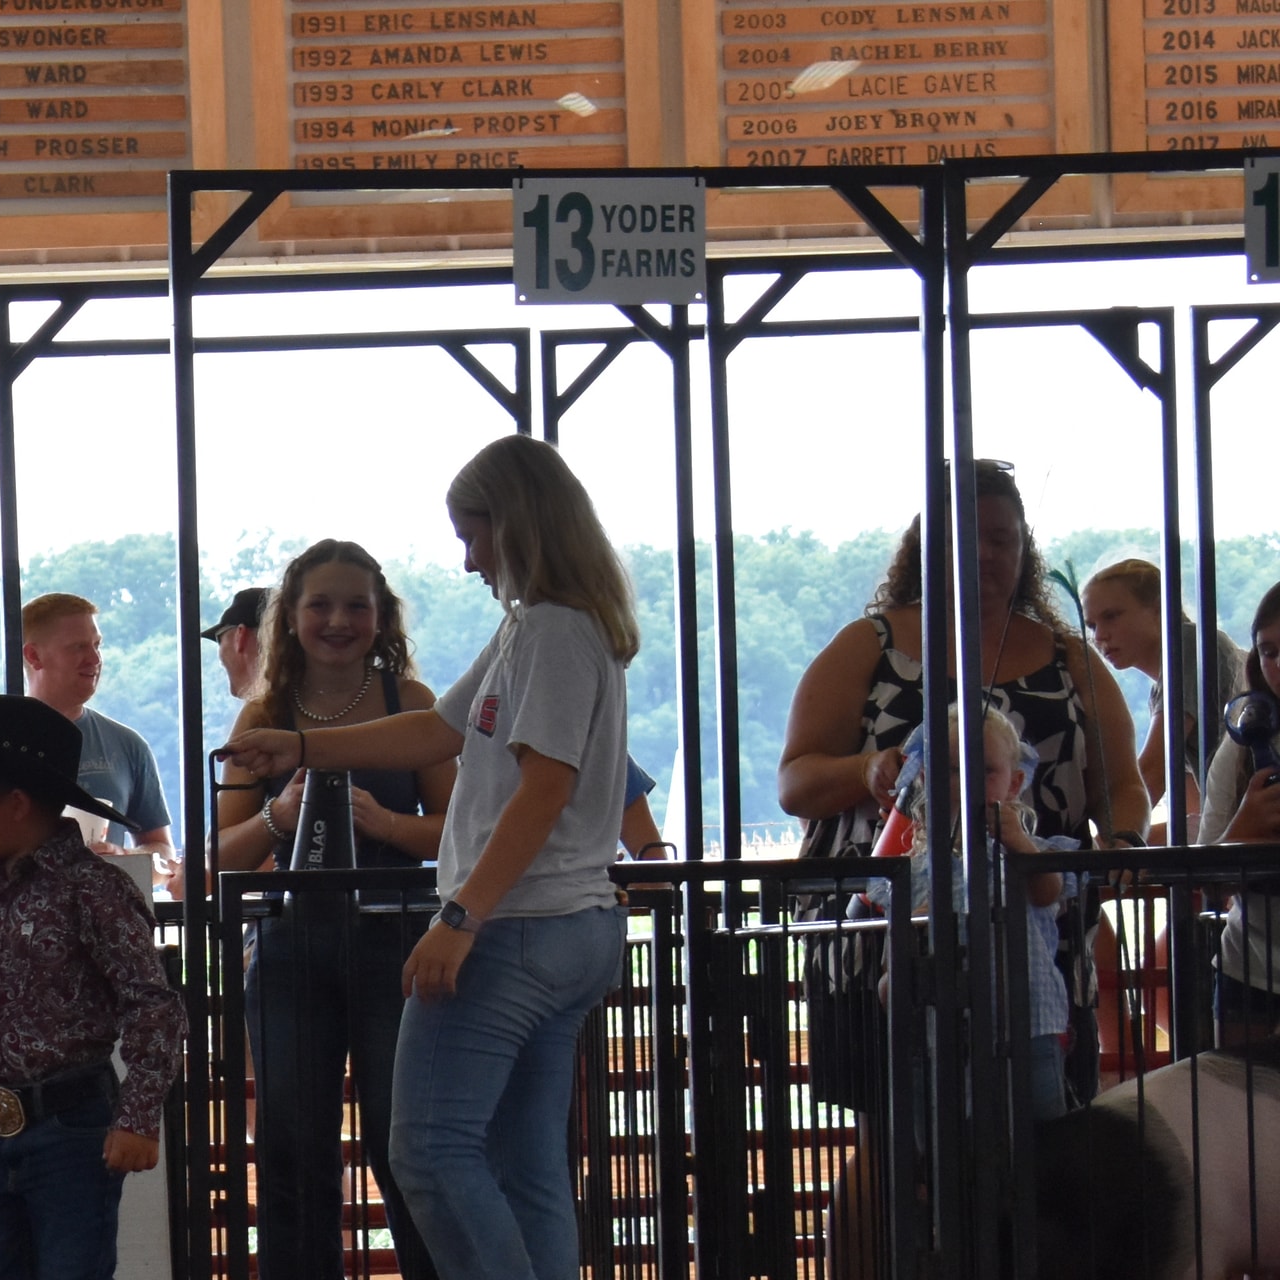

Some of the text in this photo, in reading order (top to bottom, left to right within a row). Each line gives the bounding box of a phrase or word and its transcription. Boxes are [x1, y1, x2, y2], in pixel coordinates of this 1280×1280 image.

[733, 5, 1010, 30] 2003 CODY LENSMAN
[1163, 0, 1215, 15] 2013
[299, 10, 537, 33] 1991 ERIC LENSMAN
[738, 39, 1009, 64] 2004 RACHEL BERRY
[1163, 30, 1215, 50] 2014
[299, 42, 548, 67] 1992 AMANDA LEWIS
[25, 65, 87, 83] WARD
[1164, 64, 1280, 85] 2015 MIRA
[299, 78, 534, 102] 1993 CARLY CLARK
[738, 72, 997, 101] 2005 LACIE GAVER
[26, 101, 88, 119] WARD
[1166, 100, 1280, 120] 2016 MIRA
[301, 114, 561, 139] 1994 MONICA PROPST
[742, 109, 977, 136] 2006 JOEY BROWN
[35, 137, 139, 156] PROSSER
[746, 142, 997, 167] 2007 GARRETT DALLAS
[1167, 135, 1219, 151] 2017
[302, 151, 520, 169] 1995 EMILY PRICE
[24, 175, 97, 194] CLARK
[523, 191, 696, 292] 13 YODER
[601, 248, 696, 278] FARMS
[308, 819, 327, 864] BLAQ
